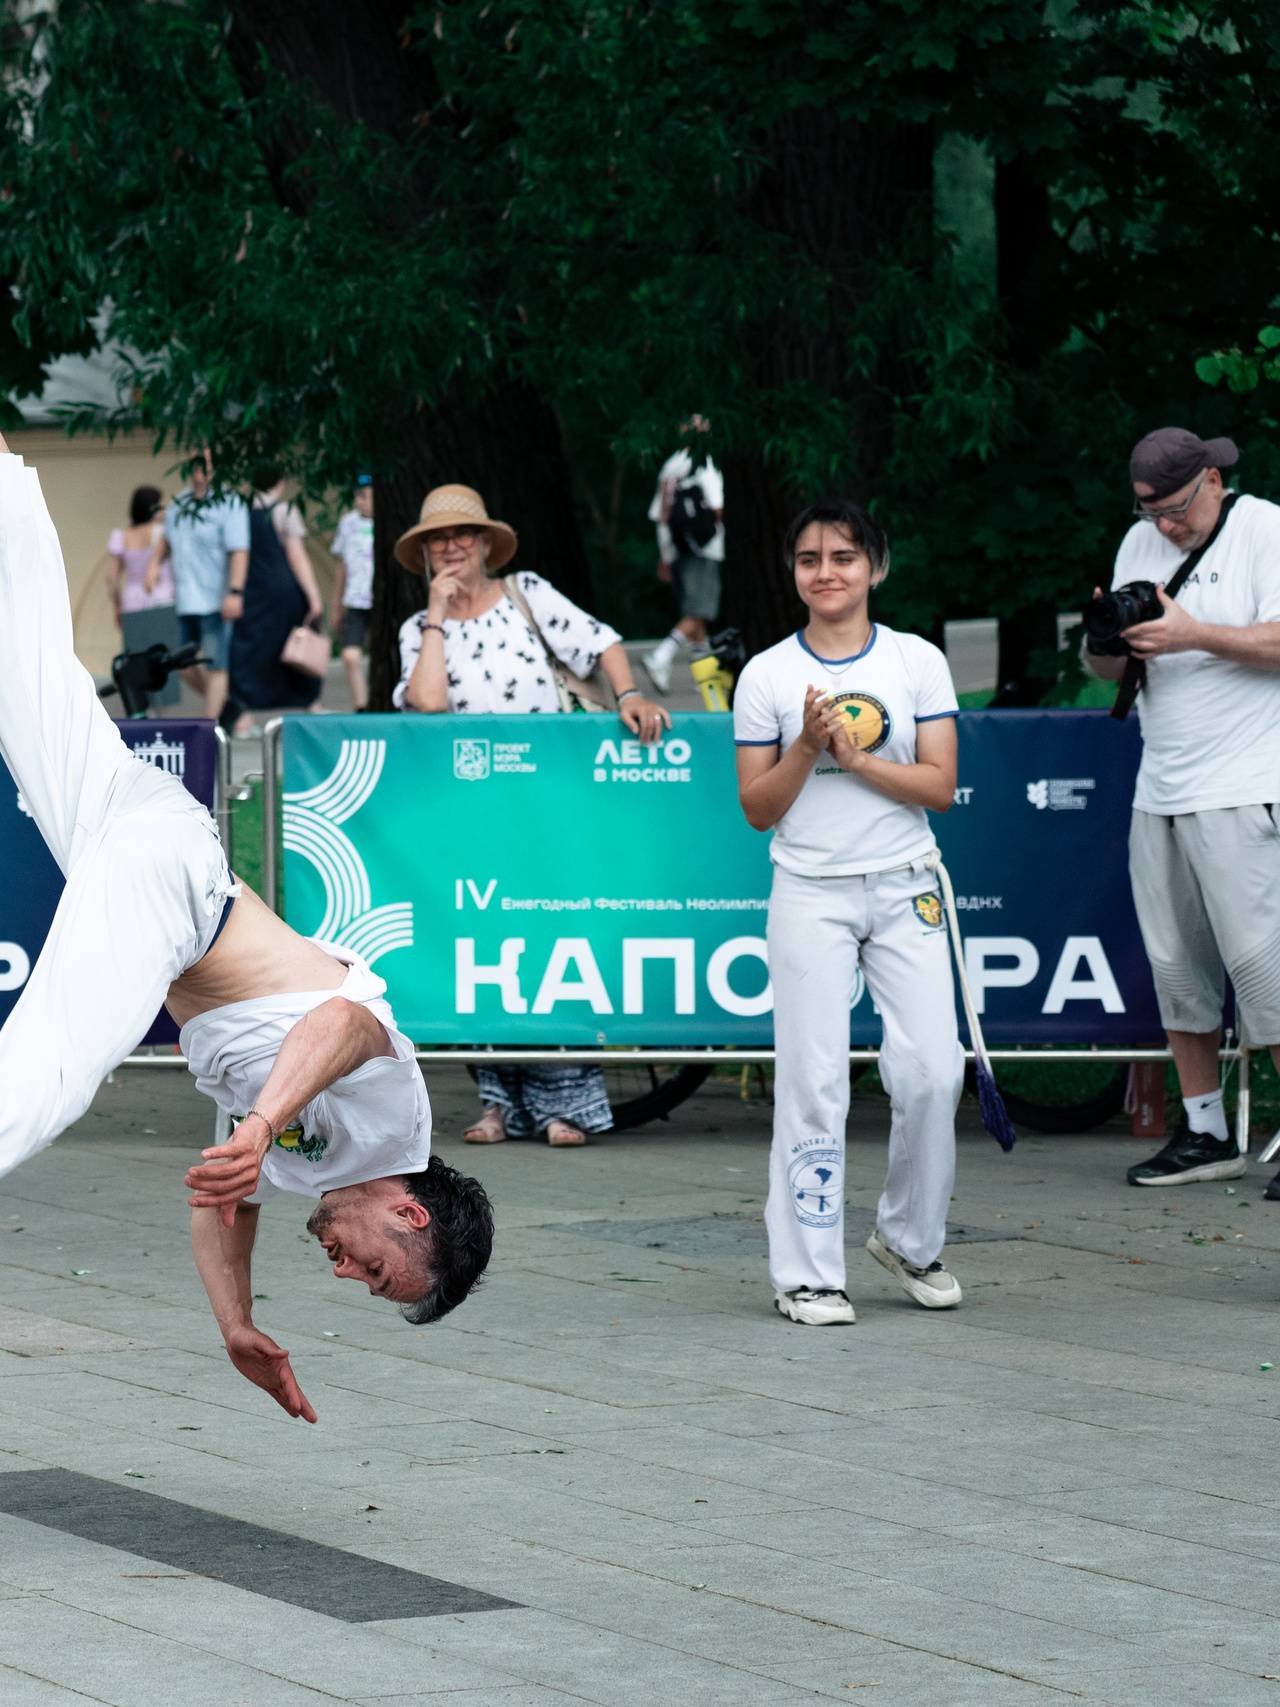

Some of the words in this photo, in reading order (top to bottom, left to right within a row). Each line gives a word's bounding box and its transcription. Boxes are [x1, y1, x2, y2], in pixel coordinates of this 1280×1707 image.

[493, 743, 531, 753] ПРОЕКТ
[595, 739, 692, 765] ЛЕТО
[493, 763, 537, 772] МОСКВЫ
[594, 768, 607, 782] В
[612, 768, 691, 782] МОСКВЕ
[455, 878, 498, 910] IV
[501, 898, 591, 911] Ежегодный
[594, 898, 682, 911] Фестиваль
[686, 898, 770, 910] Неолимпи
[956, 896, 1003, 910] ВДНХ
[791, 1137, 826, 1154] MESTRE
